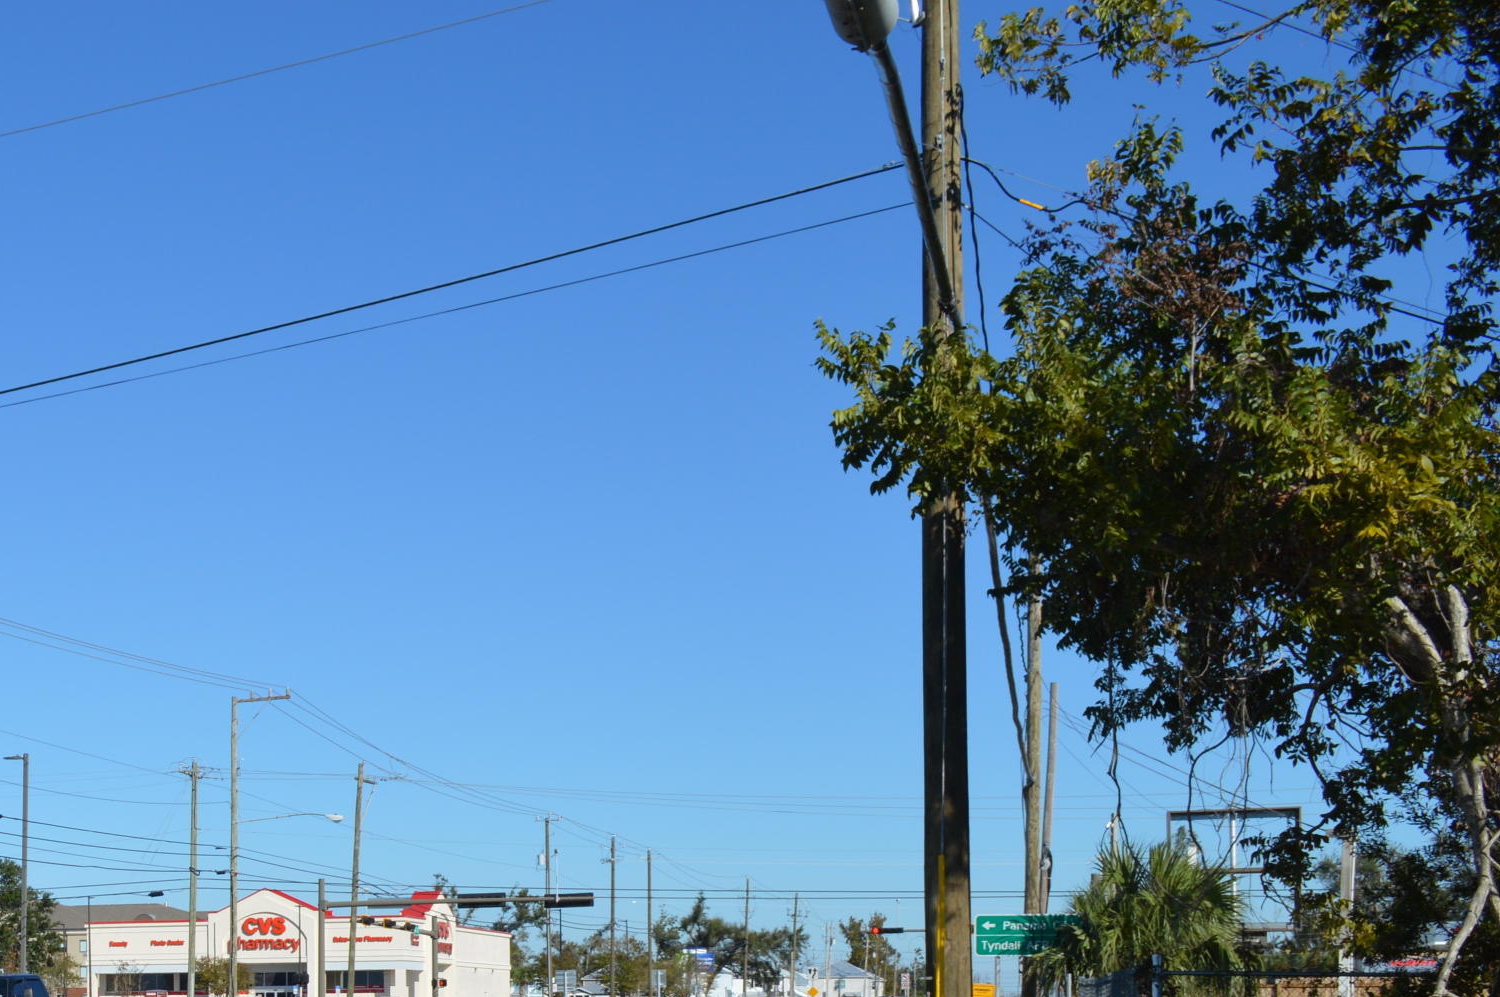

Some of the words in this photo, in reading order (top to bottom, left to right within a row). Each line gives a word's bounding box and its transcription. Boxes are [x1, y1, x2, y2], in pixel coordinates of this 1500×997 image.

[241, 917, 286, 936] CVS
[1003, 921, 1047, 931] Panama
[981, 941, 1020, 952] Tyndall
